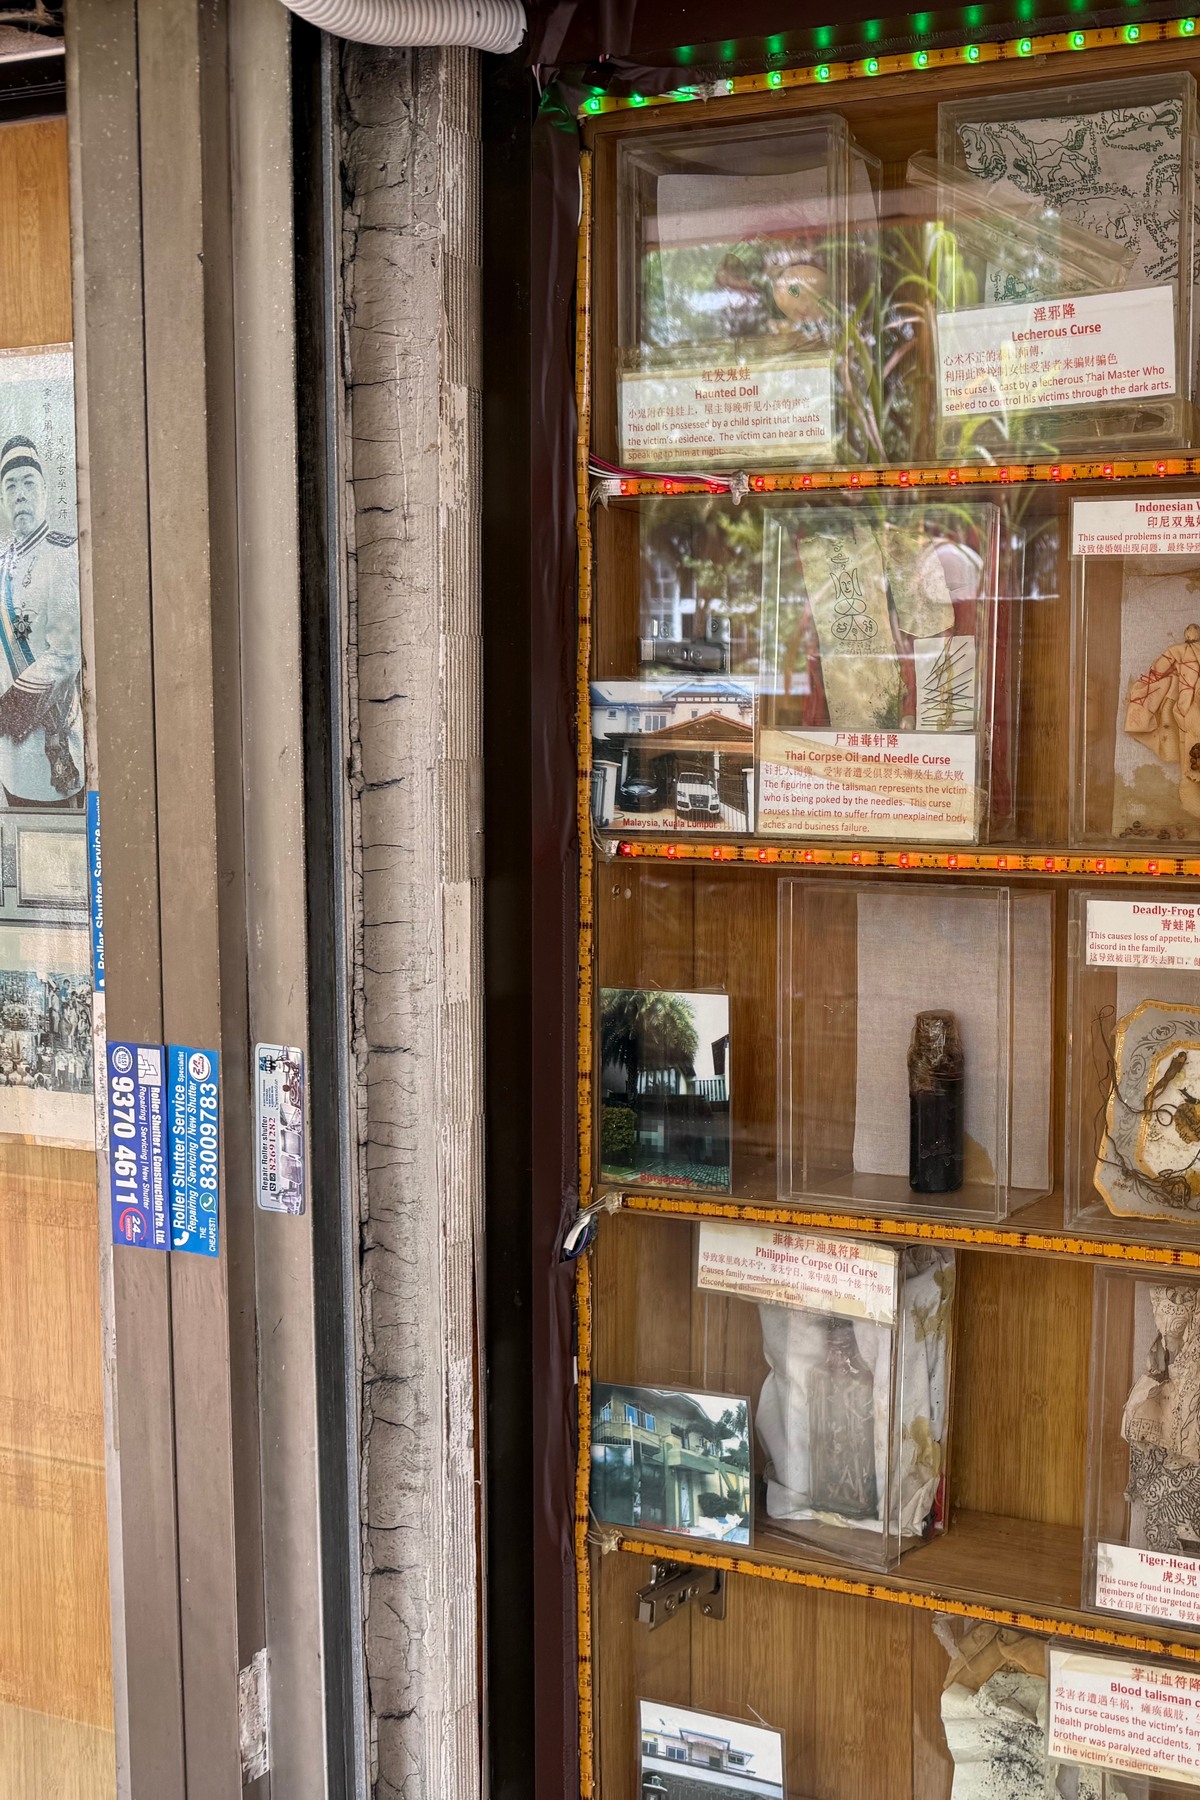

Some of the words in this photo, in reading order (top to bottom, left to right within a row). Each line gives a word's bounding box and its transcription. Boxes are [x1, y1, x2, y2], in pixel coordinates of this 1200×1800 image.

[1033, 303, 1076, 321] 淫邪降
[1011, 328, 1067, 342] Lecherous
[1070, 325, 1101, 336] Curse
[695, 386, 736, 400] Haunted
[739, 385, 758, 398] Doll
[1136, 502, 1193, 513] Indonesian
[834, 733, 899, 747] 尸油毒针降
[785, 751, 806, 761] Thai
[808, 751, 843, 764] Corpse
[845, 752, 859, 762] Oil
[861, 753, 880, 763] and
[883, 753, 919, 764] Needle
[922, 754, 951, 764] Curse
[623, 818, 660, 828] Malaysia,
[1132, 905, 1195, 919] Deadly-Frog
[1161, 919, 1196, 932] 青蛙降
[177, 1051, 185, 1082] Specialist
[111, 1077, 136, 1139] 9370
[138, 1086, 147, 1122] Repairing
[151, 1087, 160, 1113] Roller
[172, 1084, 185, 1135] Service
[187, 1081, 197, 1114] Shutter
[152, 1114, 161, 1146] Shutter
[187, 1116, 197, 1136] New
[200, 1083, 217, 1190] 83009783
[140, 1126, 148, 1160] Servicing
[268, 1117, 276, 1171] 82691282
[114, 1144, 139, 1204] 4611
[172, 1137, 185, 1187] Shutter
[187, 1142, 199, 1184] Servicing
[153, 1156, 163, 1212] Construction
[261, 1166, 269, 1191] Repair
[142, 1183, 150, 1210] Shutter
[172, 1190, 186, 1229] Roller
[155, 1212, 164, 1228] Pte.
[187, 1190, 199, 1233] Repairing
[156, 1229, 166, 1244] Ltd.
[208, 1217, 216, 1252] CHEAPEST!
[755, 1247, 799, 1265] Philippine
[801, 1255, 832, 1271] Corpse
[835, 1260, 849, 1273] Oil
[851, 1263, 878, 1278] Curse
[1138, 1552, 1196, 1572] Tiger-Head
[1162, 1571, 1198, 1587] 虎头咒
[1110, 1682, 1141, 1697] Blood
[1145, 1689, 1191, 1706] talisman
[1055, 1701, 1072, 1714] This
[1074, 1707, 1098, 1719] curse
[1100, 1712, 1129, 1725] causes
[1132, 1716, 1146, 1728] the
[1149, 1720, 1184, 1735] victim’s
